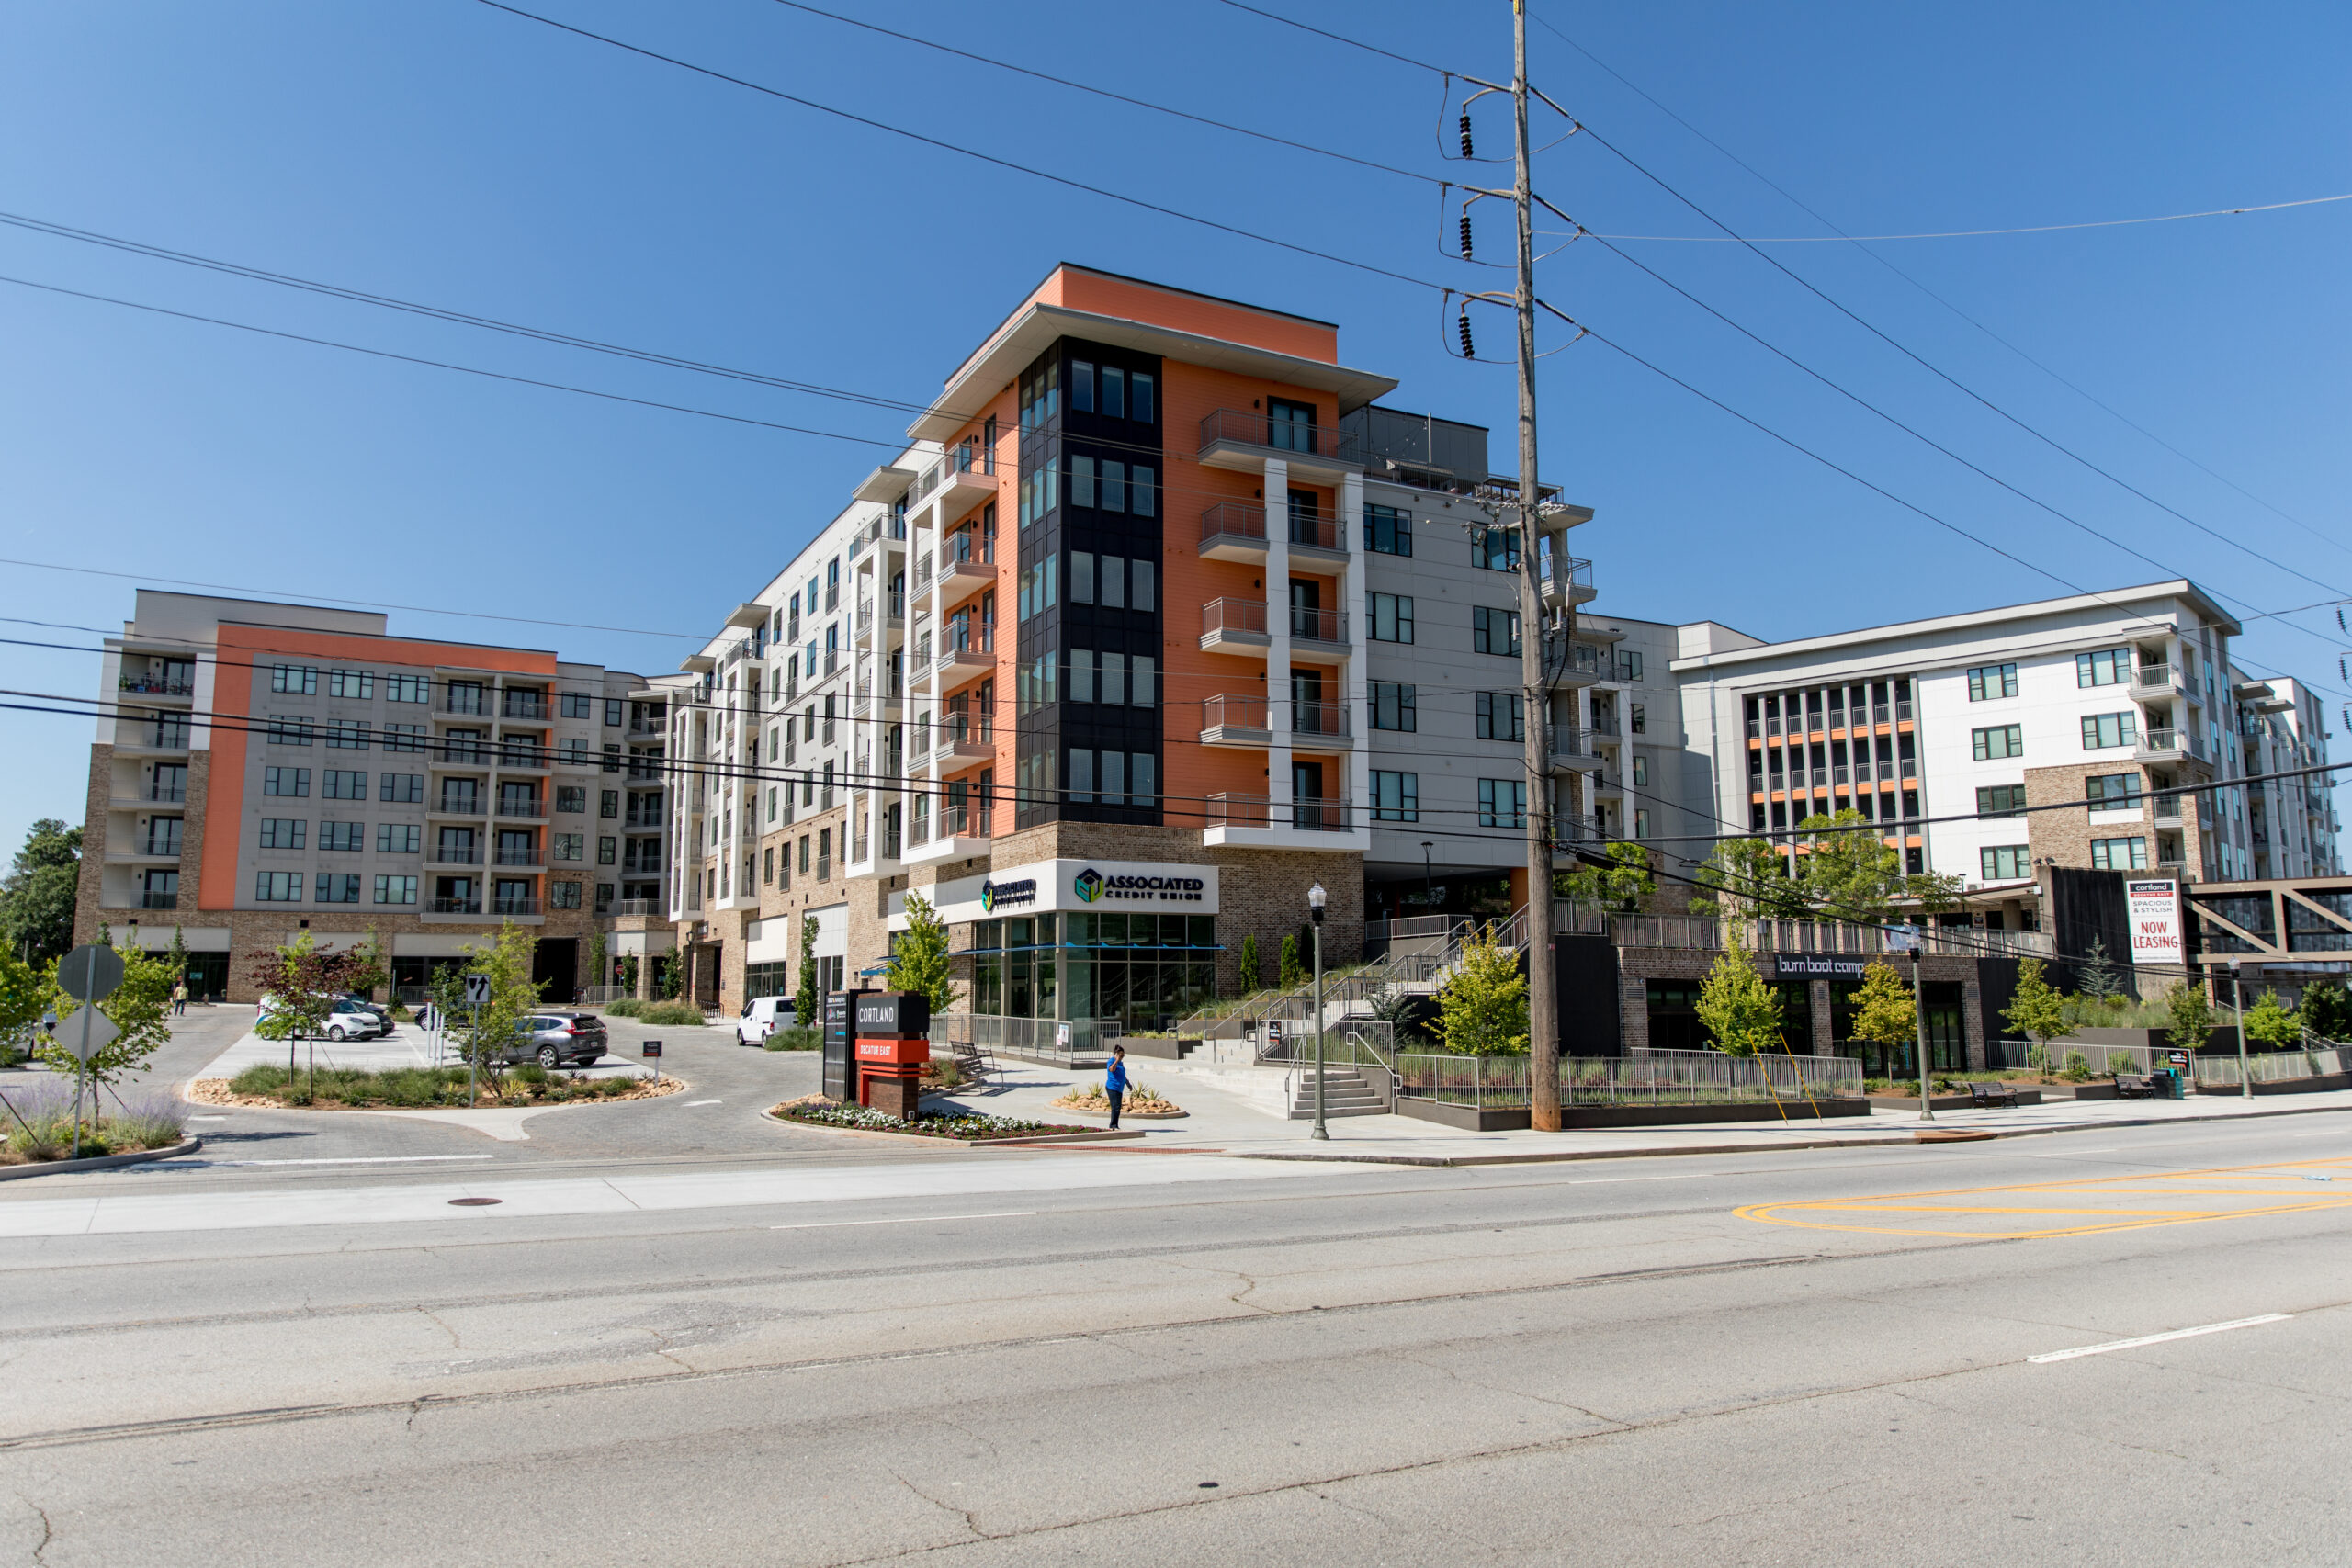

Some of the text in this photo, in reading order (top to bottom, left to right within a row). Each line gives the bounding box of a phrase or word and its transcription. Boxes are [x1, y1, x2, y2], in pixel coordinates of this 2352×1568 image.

[1105, 875, 1204, 891] ASSOCIATED
[1105, 890, 1202, 901] CREDIT UNION
[2141, 921, 2167, 934] NOW
[2133, 936, 2178, 949] LEASING
[1779, 955, 1865, 979] burn boot camp
[858, 1006, 894, 1023] CORTLAND
[860, 1044, 892, 1056] DECATUR EAST
